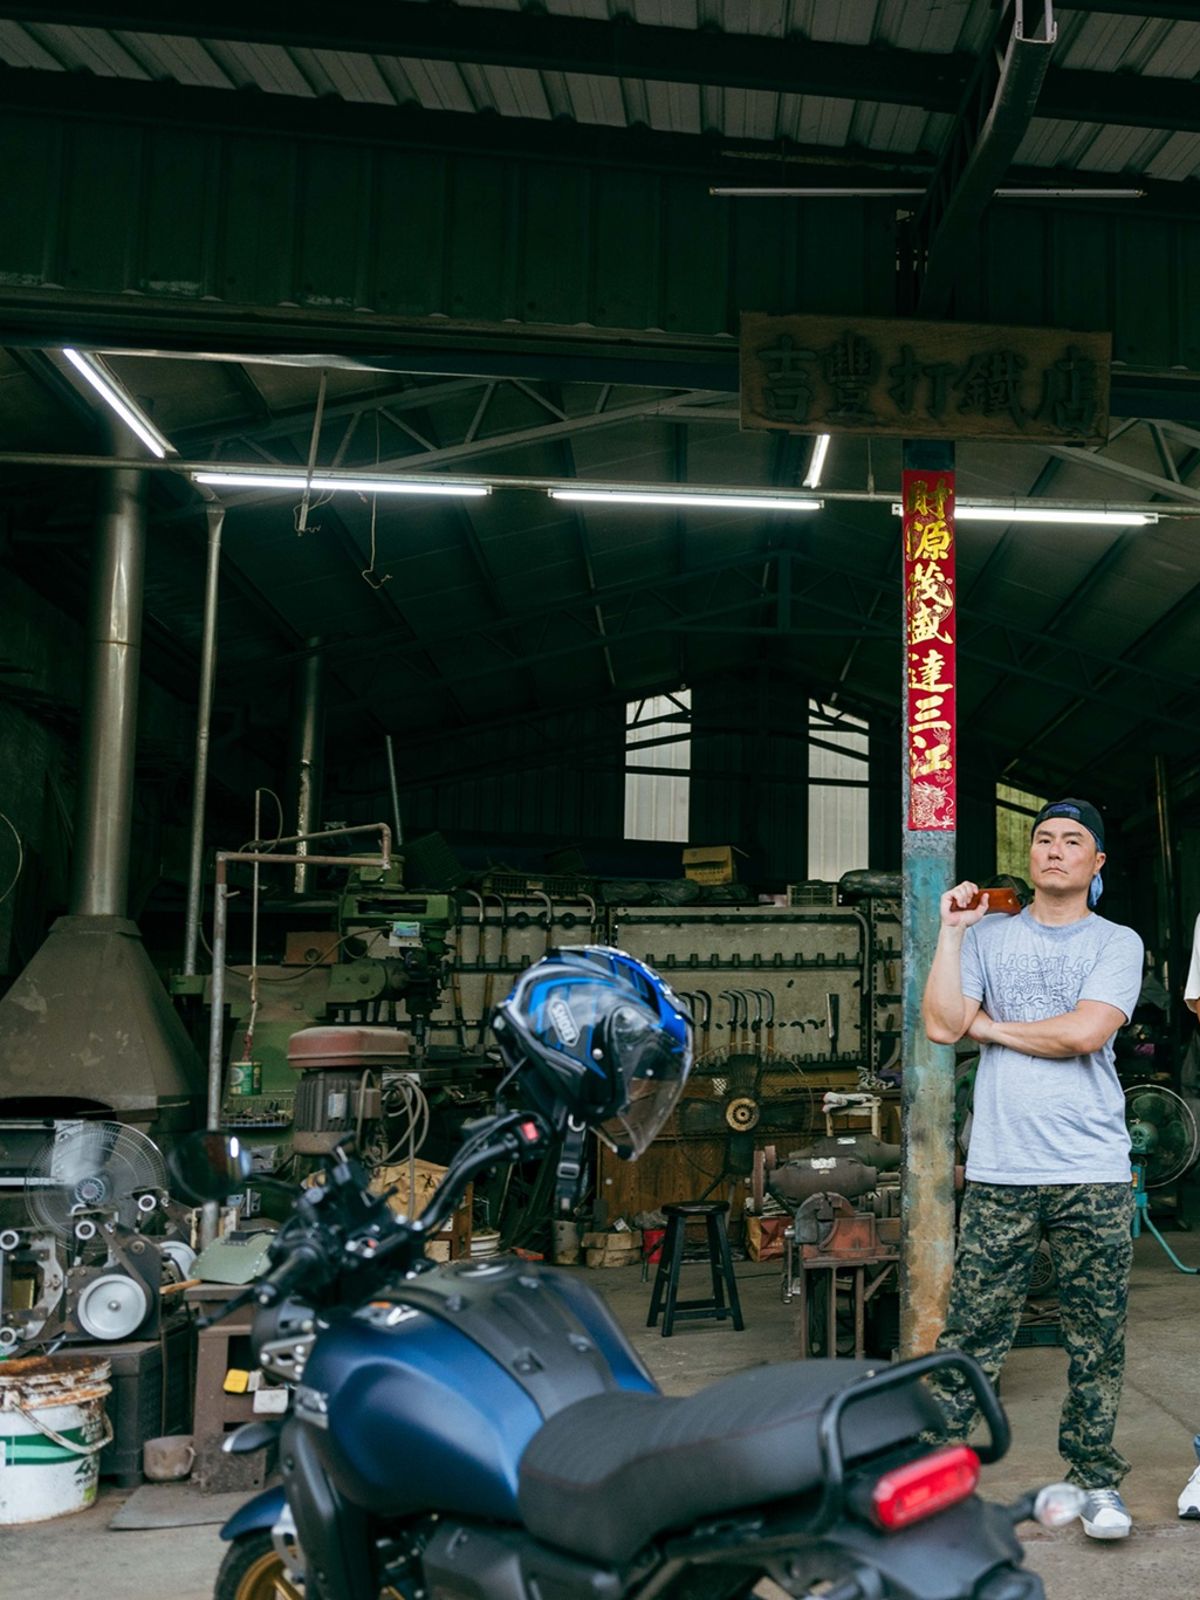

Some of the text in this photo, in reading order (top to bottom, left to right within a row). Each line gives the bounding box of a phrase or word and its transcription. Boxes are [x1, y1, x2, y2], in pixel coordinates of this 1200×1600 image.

[757, 331, 1099, 433] 吉豐打鐵店
[906, 479, 954, 779] 財源茂盛達三江
